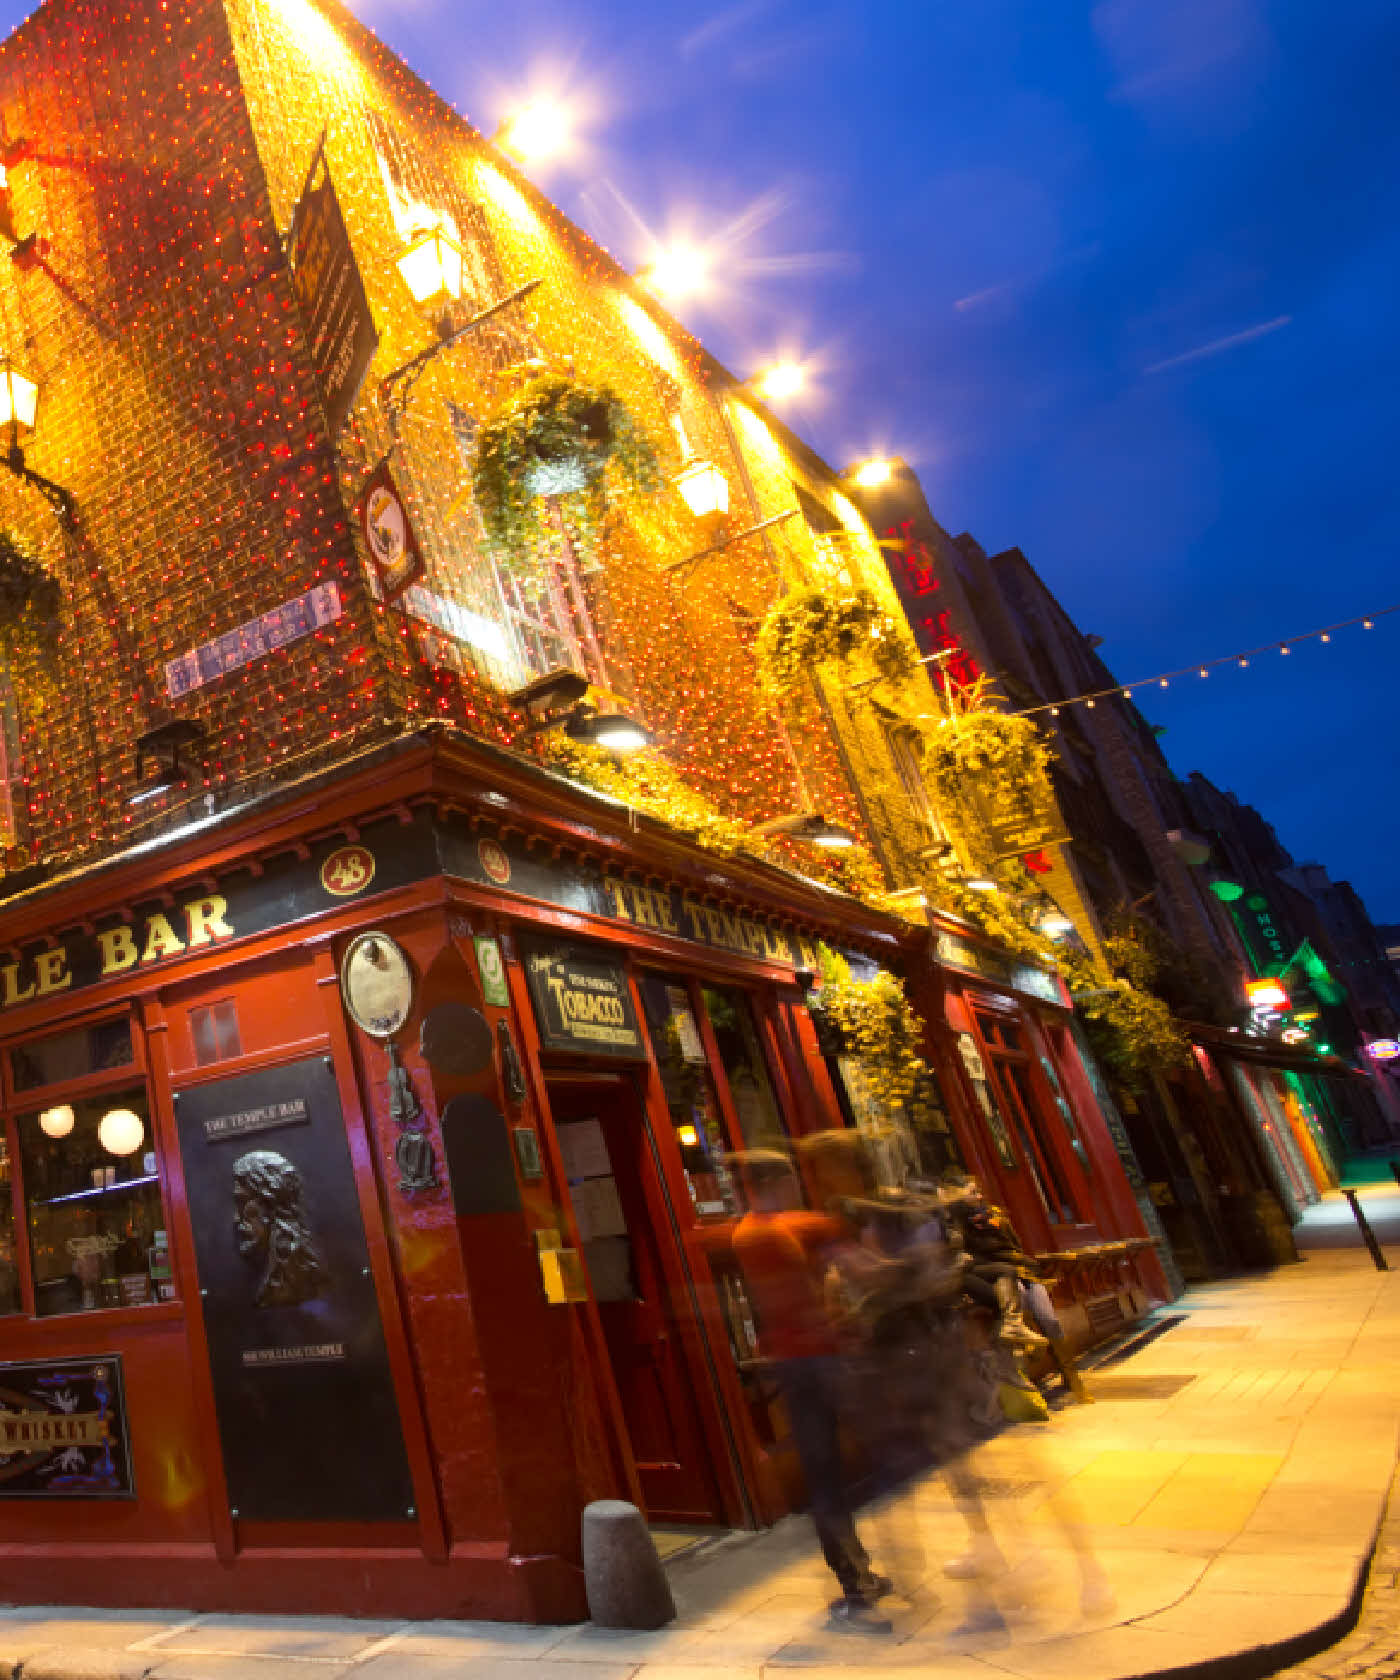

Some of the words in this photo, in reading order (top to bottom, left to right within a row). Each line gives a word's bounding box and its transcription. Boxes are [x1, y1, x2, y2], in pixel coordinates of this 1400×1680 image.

[330, 854, 366, 888] 48
[604, 877, 678, 932] THE
[97, 895, 236, 975] BAR
[547, 976, 625, 1031] TOBACCO
[3, 1420, 87, 1441] WHISKEY
